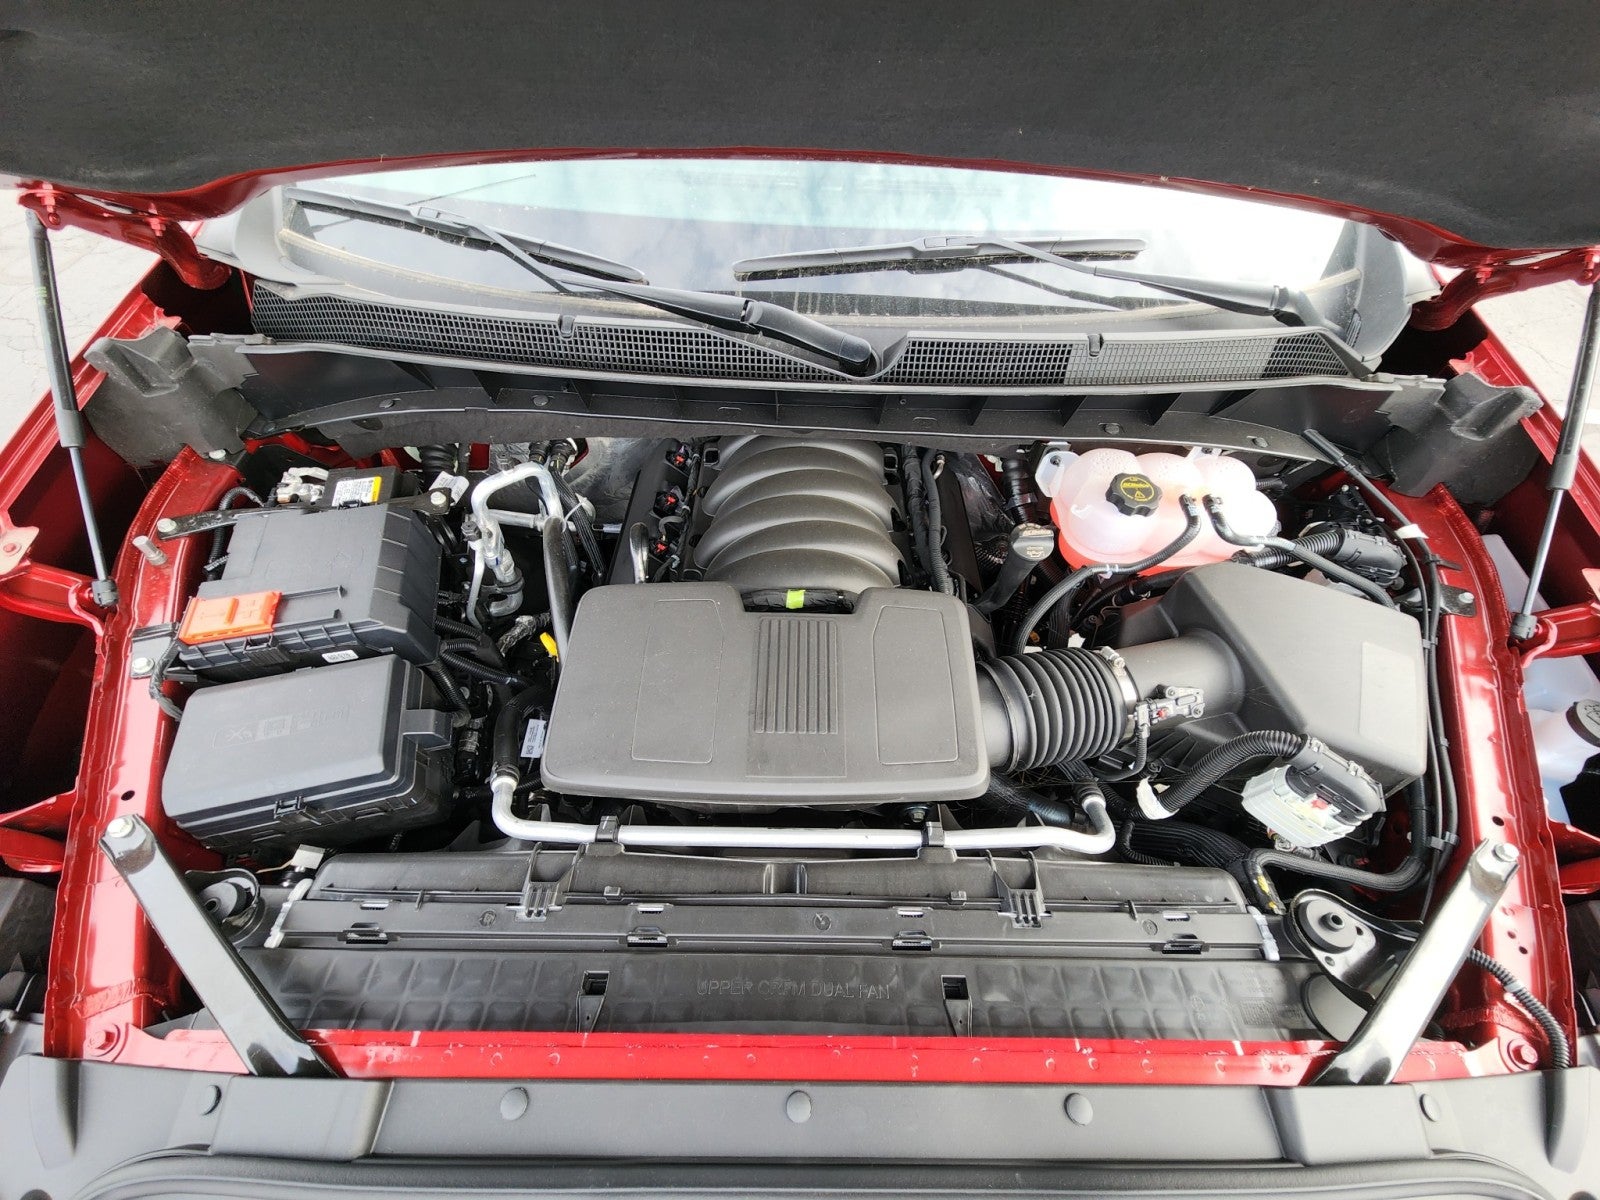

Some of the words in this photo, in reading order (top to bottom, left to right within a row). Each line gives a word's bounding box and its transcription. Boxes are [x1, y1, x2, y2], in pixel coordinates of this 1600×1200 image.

[696, 979, 753, 996] UPPER
[811, 981, 855, 998] DUAL
[858, 983, 891, 1000] FAN
